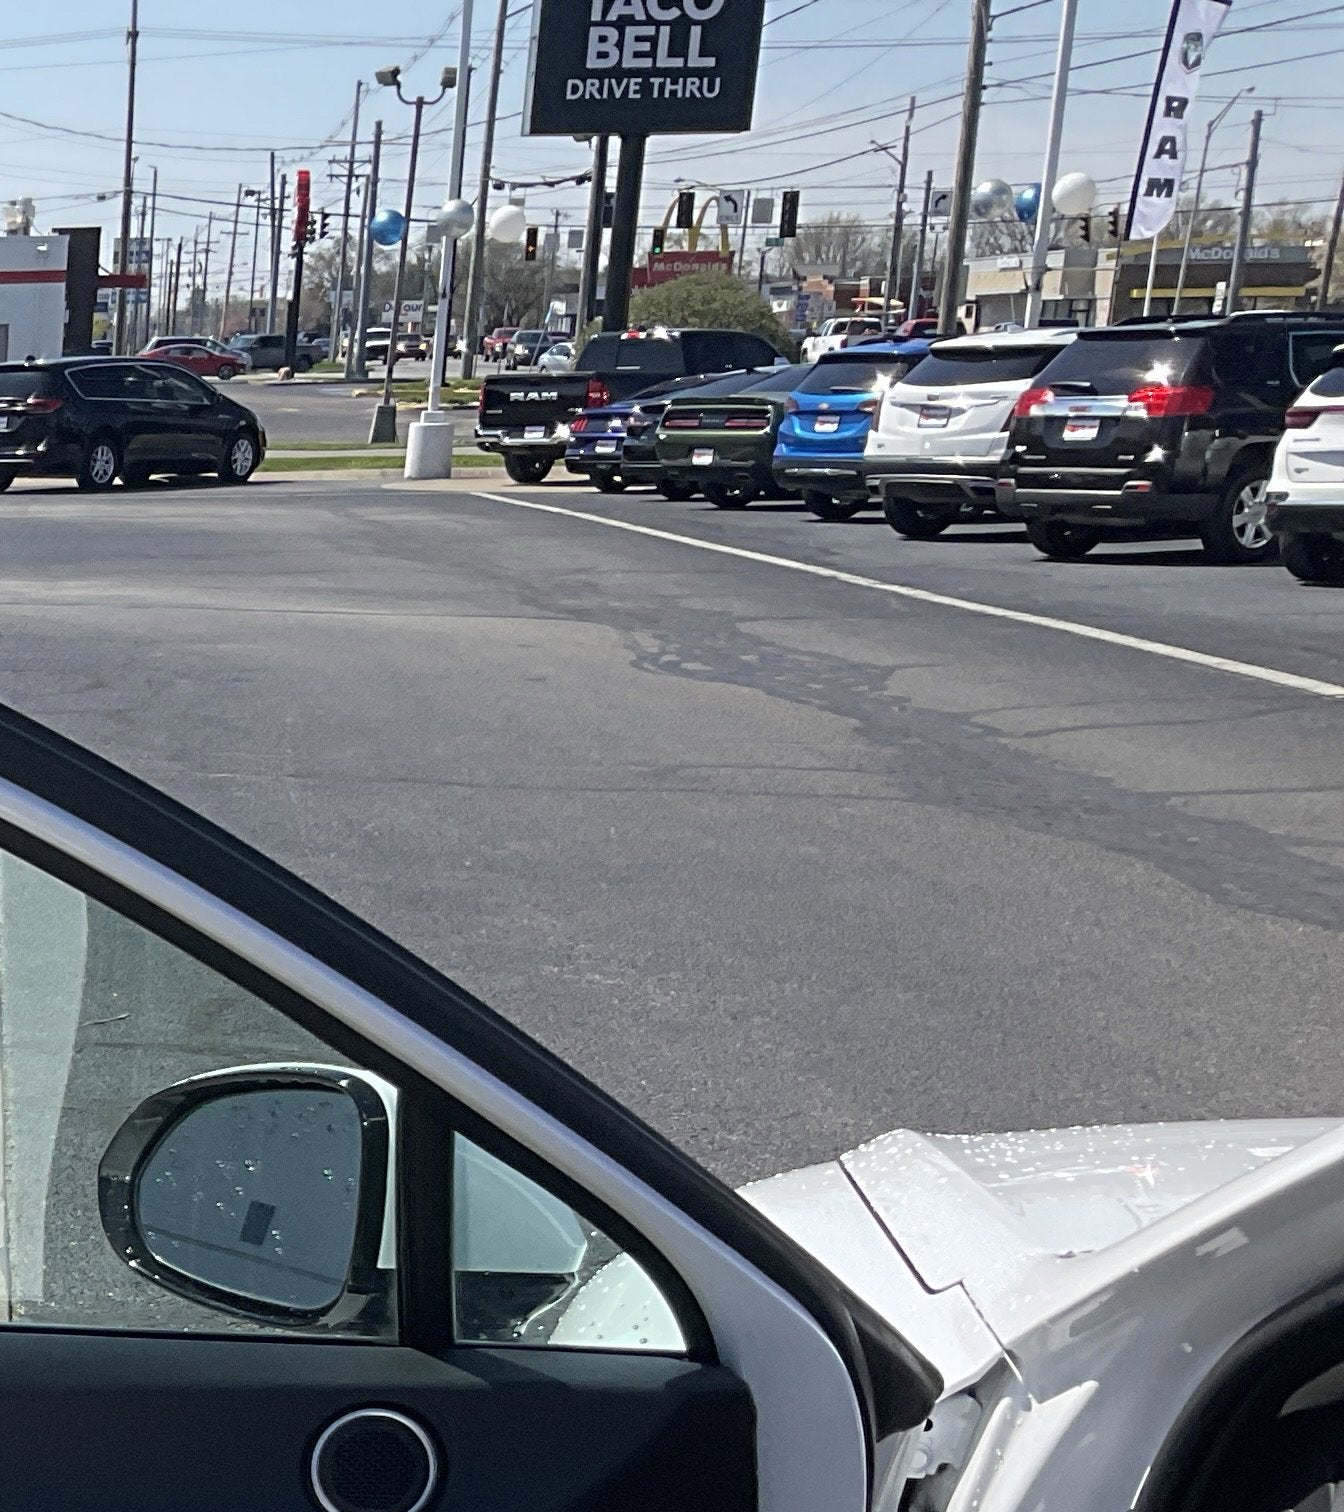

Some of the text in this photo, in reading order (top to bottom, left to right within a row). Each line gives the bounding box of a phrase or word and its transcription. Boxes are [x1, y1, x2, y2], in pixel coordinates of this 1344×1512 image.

[585, 24, 717, 69] BELL
[565, 76, 722, 101] DRIVE THRU
[1143, 95, 1189, 198] RAM
[1189, 245, 1281, 260] McDoald's
[509, 391, 559, 402] RAM
